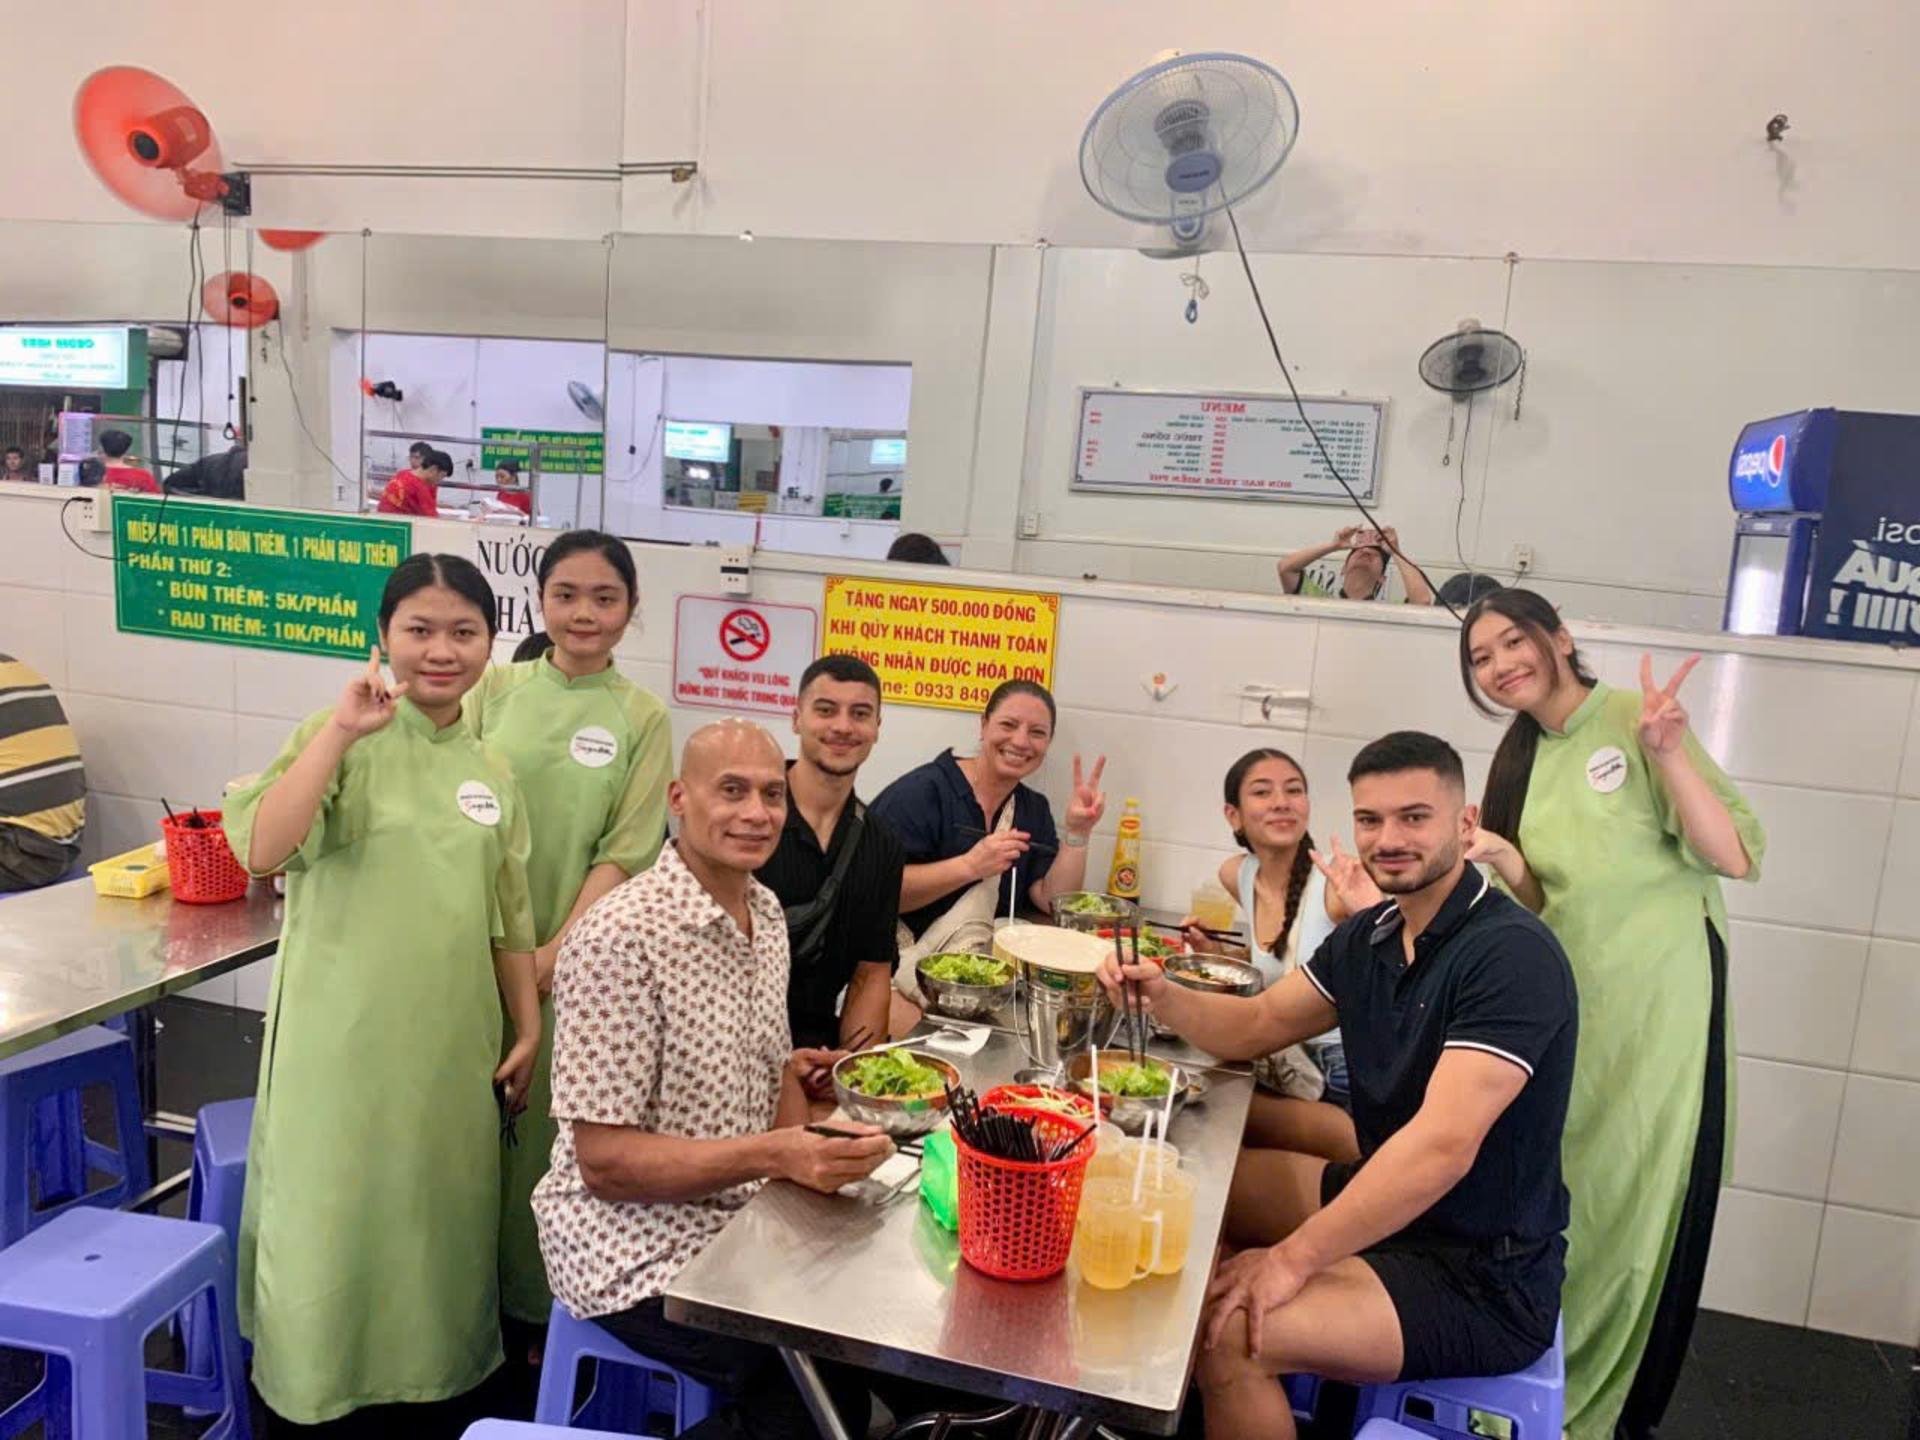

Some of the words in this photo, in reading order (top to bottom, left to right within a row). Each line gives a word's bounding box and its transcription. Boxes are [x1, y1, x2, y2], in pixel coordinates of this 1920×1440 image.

[181, 526, 188, 546] 1
[292, 535, 299, 558] 1
[339, 539, 361, 565] RAU
[216, 562, 231, 578] 2:
[170, 578, 208, 601] BÚN
[212, 584, 269, 608] THÊM:
[889, 594, 928, 612] NGAY
[931, 598, 989, 619] 500.000
[171, 610, 205, 629] RAU
[211, 613, 266, 637] THÊM:
[497, 586, 535, 635] HÀ
[830, 619, 855, 636] KHI
[893, 623, 944, 644] KHÁCH
[950, 629, 1000, 650] THANH
[1007, 632, 1047, 655] TOÁN
[914, 681, 954, 700] 0933
[960, 685, 990, 703] 849
